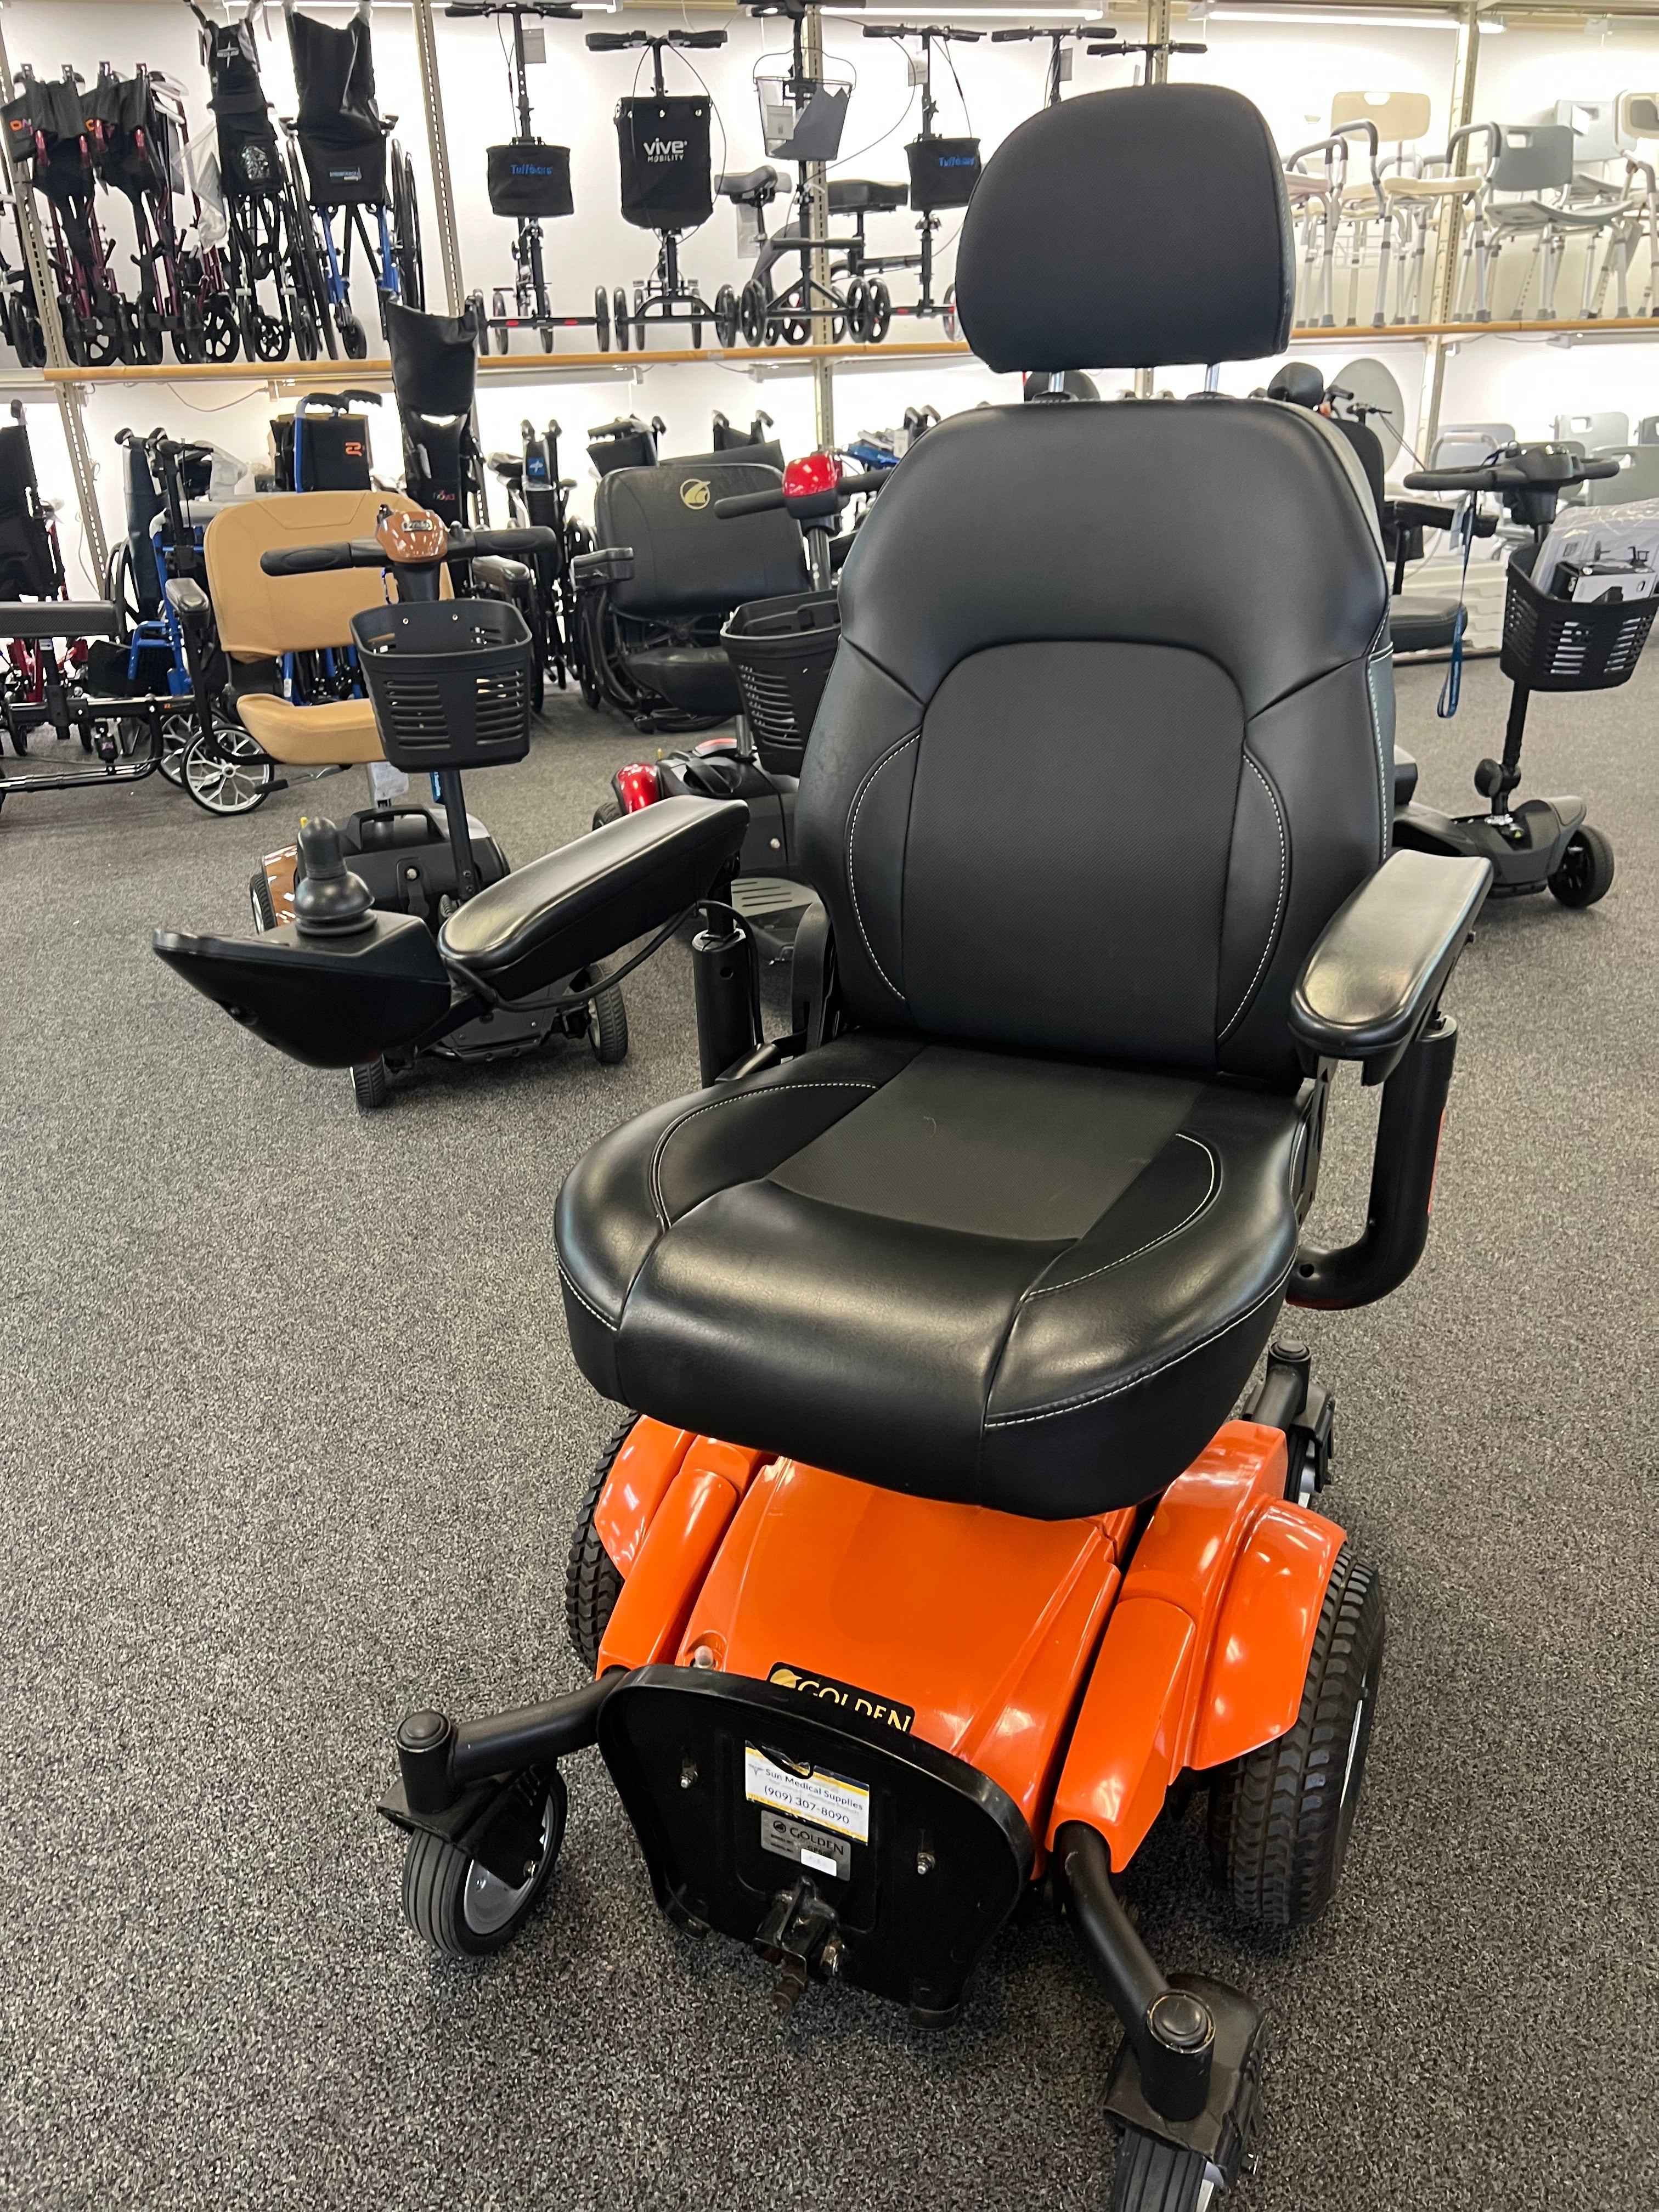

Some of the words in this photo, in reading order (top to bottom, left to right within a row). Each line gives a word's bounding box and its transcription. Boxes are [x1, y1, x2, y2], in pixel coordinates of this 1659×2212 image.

[644, 138, 684, 155] vive
[648, 154, 684, 163] MOBILITY
[766, 1769, 782, 1780] Sun
[785, 1775, 821, 1795] Medical
[824, 1790, 863, 1810] Supplies
[765, 1785, 792, 1804] (909)
[795, 1797, 850, 1825] 307-8090
[789, 1827, 844, 1855] GOLDEN
